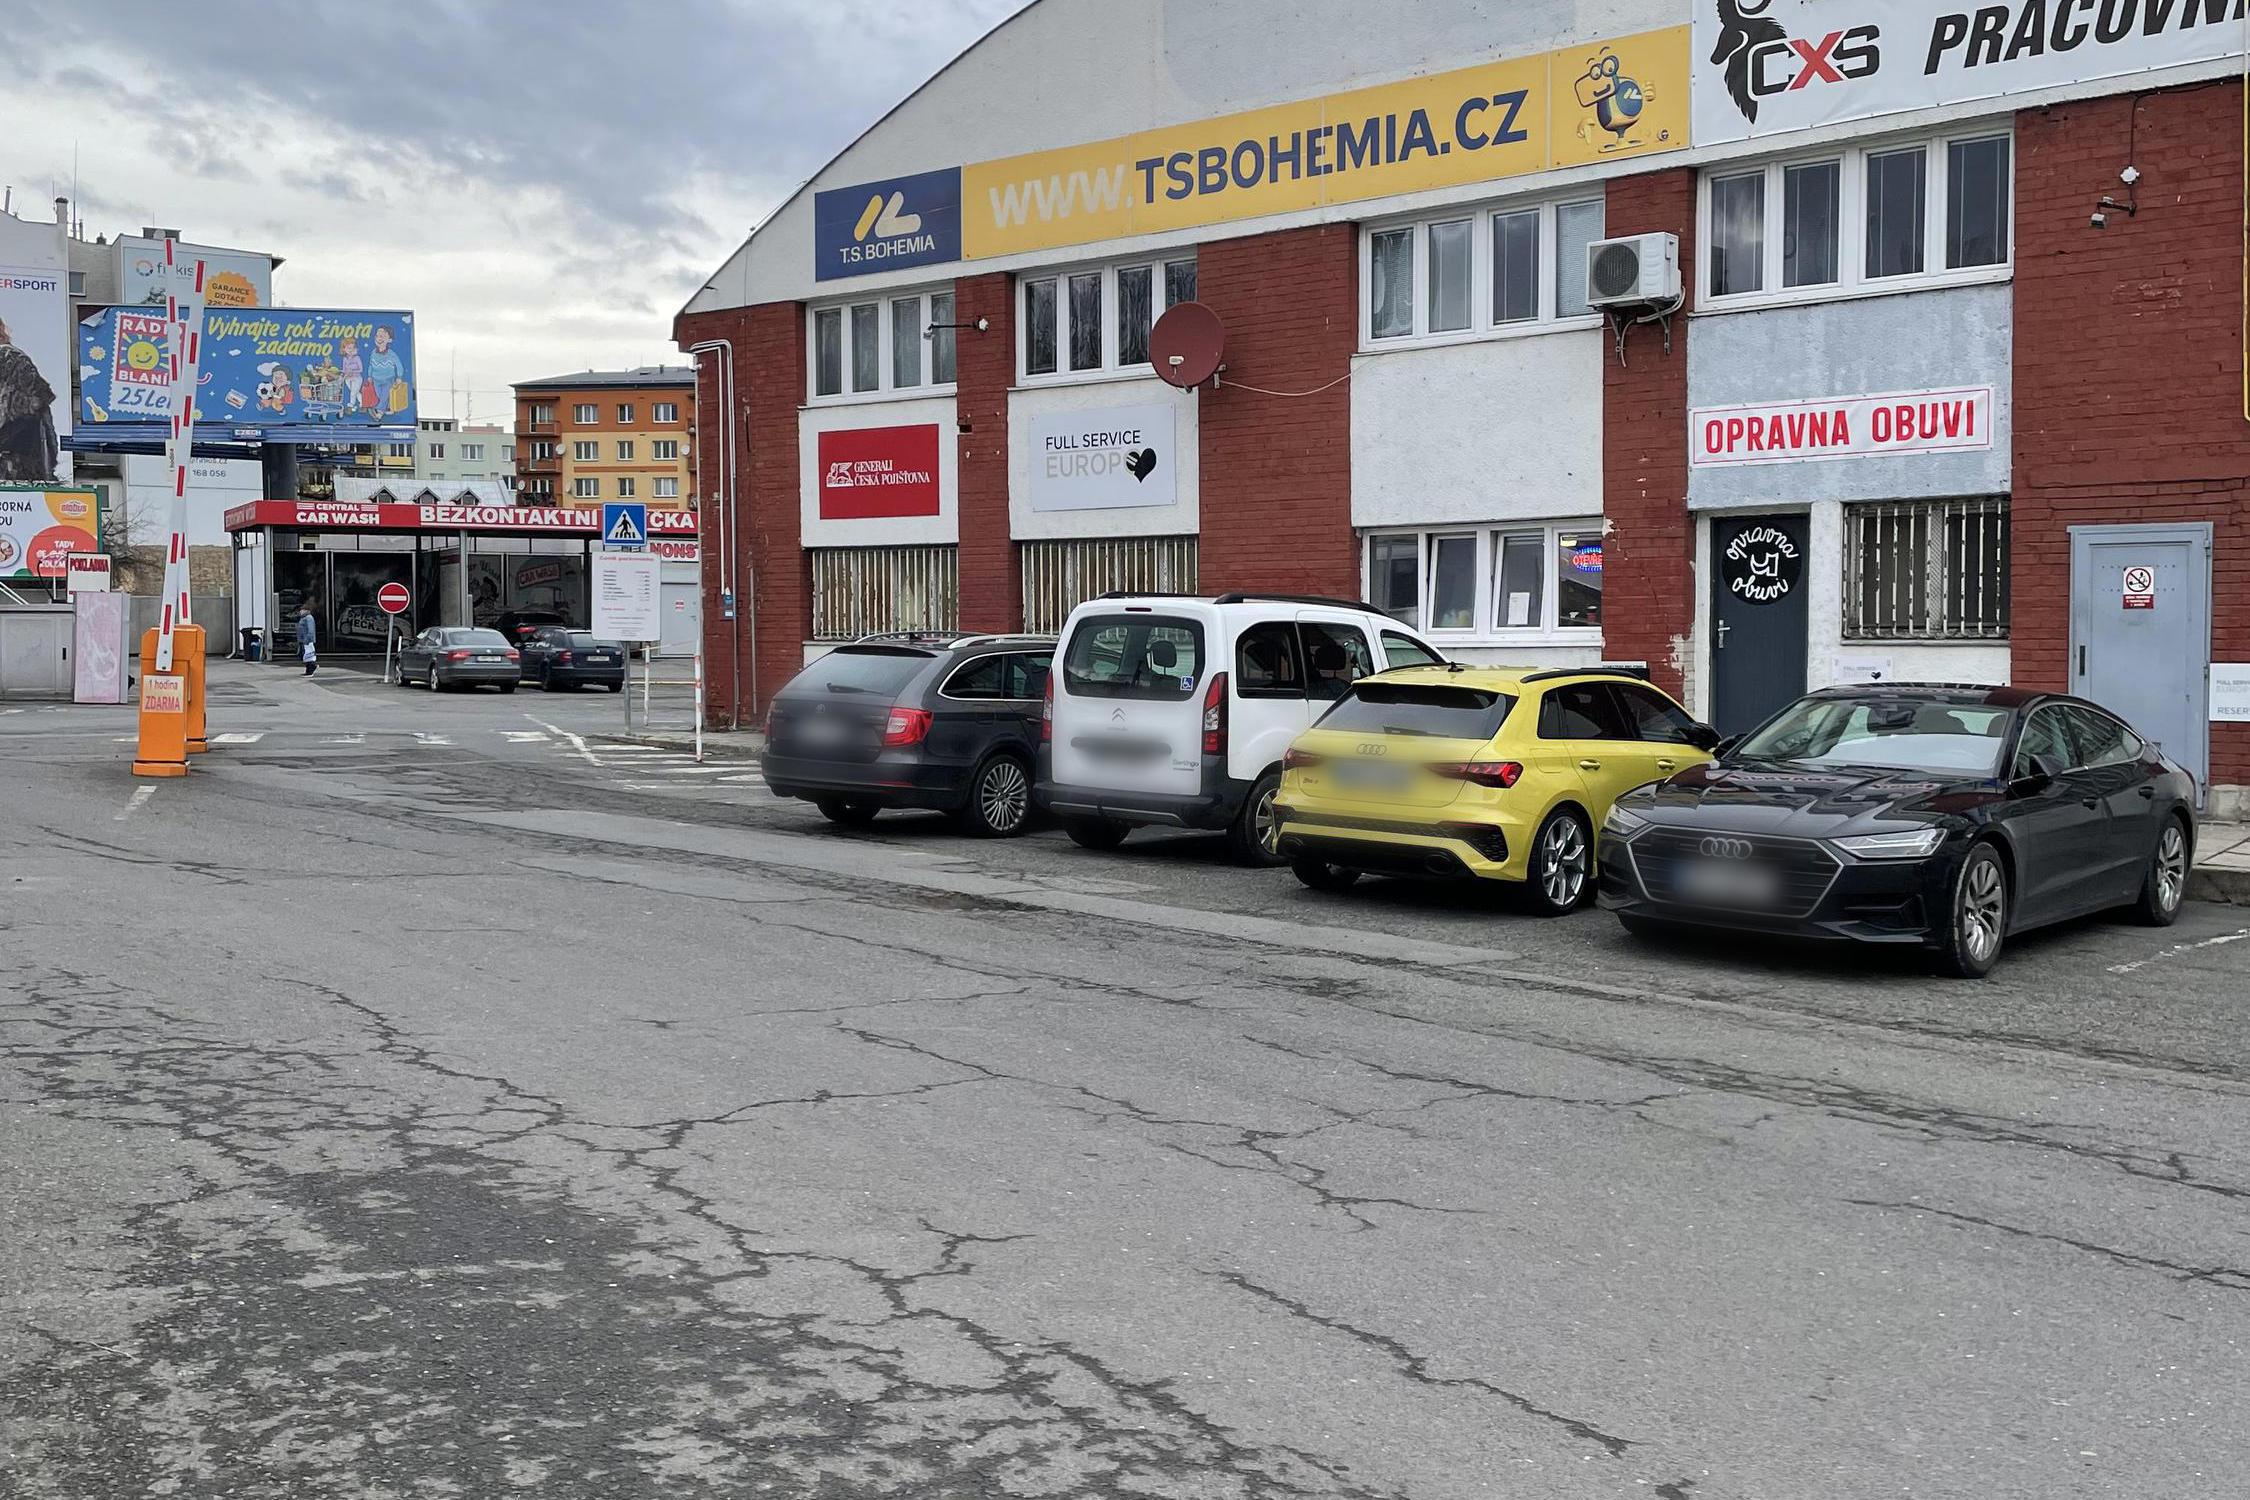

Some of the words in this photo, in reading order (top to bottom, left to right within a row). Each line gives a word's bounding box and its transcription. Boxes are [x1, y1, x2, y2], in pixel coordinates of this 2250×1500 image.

[1752, 25, 1880, 96] CXS
[840, 246, 863, 263] T.S.
[865, 234, 935, 260] BOHEMIA
[157, 262, 194, 276] fikis
[212, 283, 250, 296] GARANCE
[215, 292, 246, 303] DOTACE
[208, 316, 280, 341] Vyhrajte
[284, 319, 315, 338] rok
[319, 320, 372, 339] života
[255, 338, 333, 356] zadarmo
[118, 370, 170, 386] BLANÍ
[1705, 411, 1850, 454] OPRAVNA
[1871, 400, 1974, 442] OBUVI
[1045, 435, 1079, 450] FULL
[1082, 430, 1141, 448] SERVICE
[854, 460, 893, 473] GENERALI
[854, 473, 880, 487] ČESKÁ
[0, 499, 32, 512] ORNÁ
[316, 503, 360, 511] CENTRAL
[296, 512, 329, 524] CAR
[331, 513, 380, 525] WASH
[420, 506, 598, 527] BEZKONTAKTNÍ
[647, 511, 695, 529] ČKA
[54, 540, 75, 549] TADY
[650, 542, 698, 559] NONS
[1726, 526, 1799, 560] opravna
[1573, 553, 1603, 566] OTEVŘE
[1731, 575, 1789, 601] obuvi
[145, 695, 180, 710] ZDARMA
[2217, 706, 2250, 715] RESER
